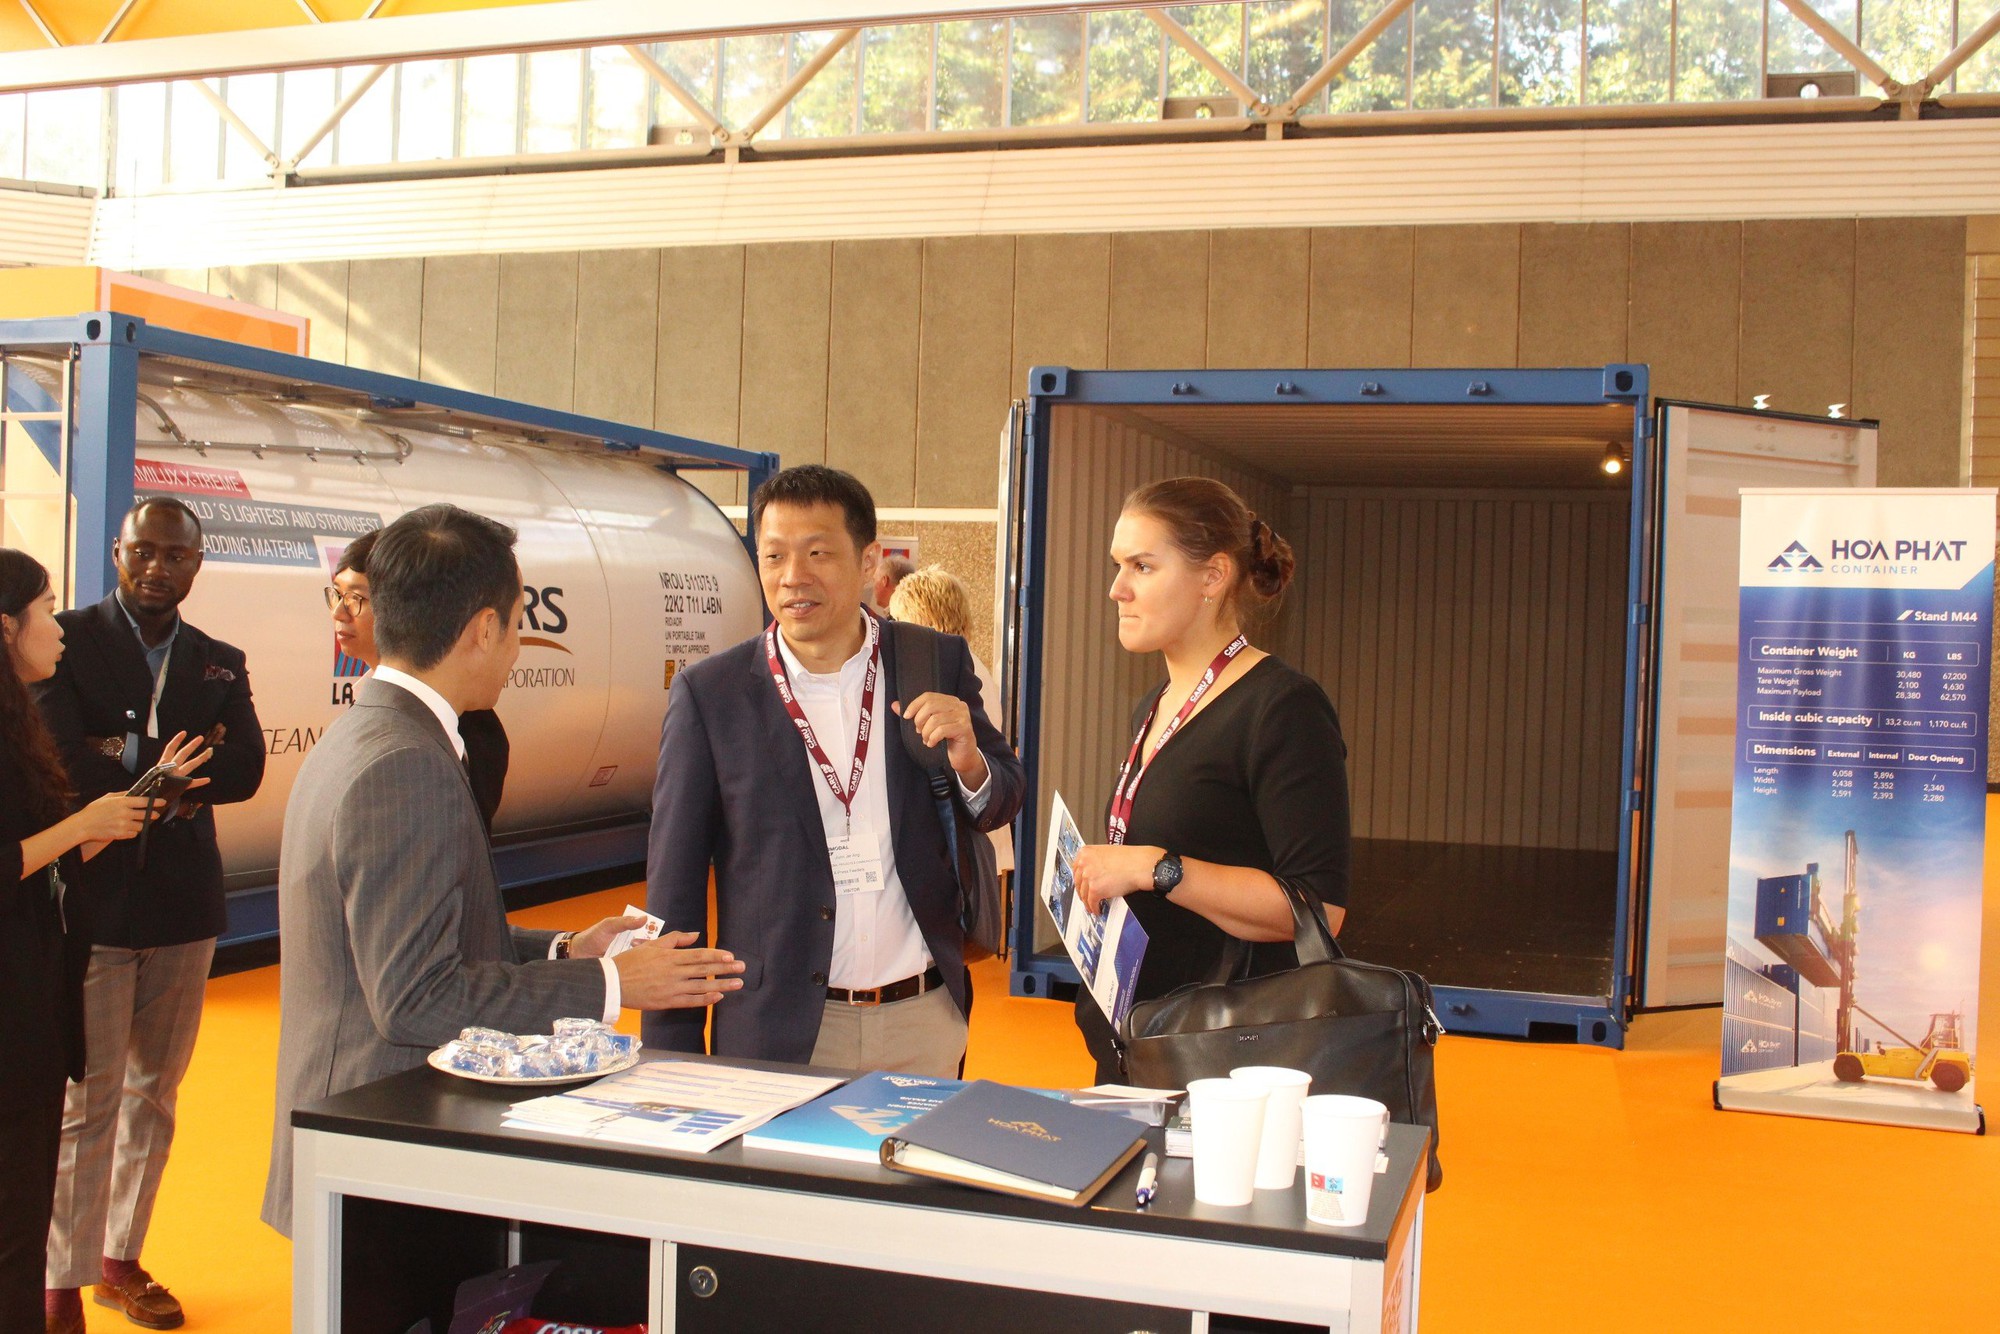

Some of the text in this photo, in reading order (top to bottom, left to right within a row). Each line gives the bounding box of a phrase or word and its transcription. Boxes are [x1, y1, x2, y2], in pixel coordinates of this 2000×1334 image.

[181, 470, 243, 493] X-TREME
[232, 506, 289, 527] LIGHTEST
[292, 511, 316, 529] AND
[316, 514, 381, 532] STRONGEST
[199, 534, 314, 560] ADDING MATERIAL
[1831, 564, 1918, 574] CONTAINER
[664, 595, 684, 613] 22K2
[701, 597, 722, 615] L4BN
[1914, 610, 1978, 622] Stand M44
[672, 631, 694, 641] PORTABLE
[1223, 638, 1242, 656] CARU
[1760, 645, 1963, 661] Container Weight KG LBS
[503, 667, 575, 688] PORATION
[1757, 667, 1967, 681] Maximum Gross Weight 30,480 67,200
[778, 683, 791, 704] CARU
[1189, 680, 1207, 702] CARU
[1757, 677, 1965, 692] Tare Weight 2,100 4,630
[1757, 688, 1967, 702] Maximum Payload 28,380 62,570
[858, 719, 869, 741] CARU
[1759, 711, 1792, 722] Inside
[1794, 712, 1824, 723] cubic
[1826, 714, 1873, 727] capacity
[1885, 718, 1901, 727] 33,2
[1928, 720, 1949, 729] 1,170
[1950, 721, 1968, 729] cu.ft
[262, 726, 323, 755] CEAN
[800, 728, 815, 749] CARU
[1155, 728, 1173, 750] CARU
[1753, 744, 1964, 764] Dimensions External Internal Door Opening
[1753, 766, 1779, 775] Length
[1832, 769, 1853, 778] 6,058
[1873, 771, 1895, 780] 5,896
[827, 773, 840, 795] CARU
[1753, 776, 1945, 792] Width 2,438 2,352 2,340
[1753, 786, 1944, 802] Height 2,591 2,393 2,280
